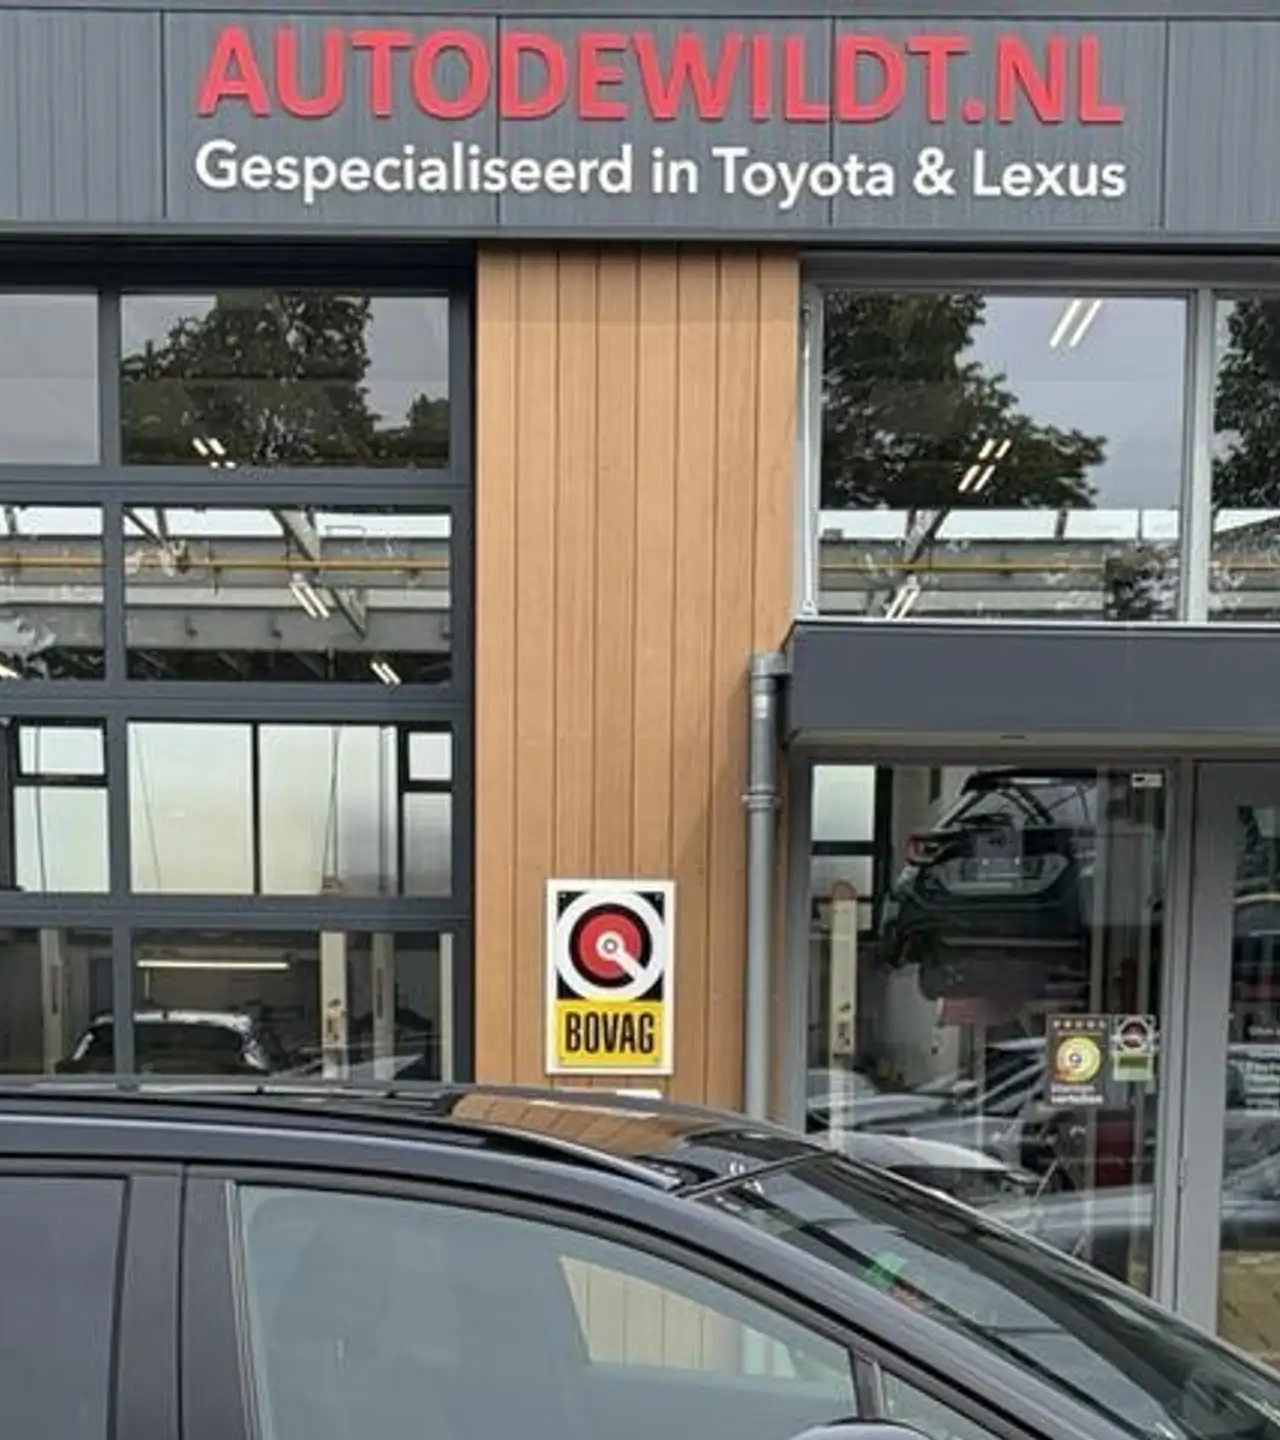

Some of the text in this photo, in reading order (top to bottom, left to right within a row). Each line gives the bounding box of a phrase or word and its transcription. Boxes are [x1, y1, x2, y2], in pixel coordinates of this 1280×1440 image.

[196, 26, 1124, 124] AUTODEWILDT.NL
[195, 141, 1126, 209] Gespecialiseerd in Toyota & Lexus
[564, 1011, 655, 1054] BOVAG
